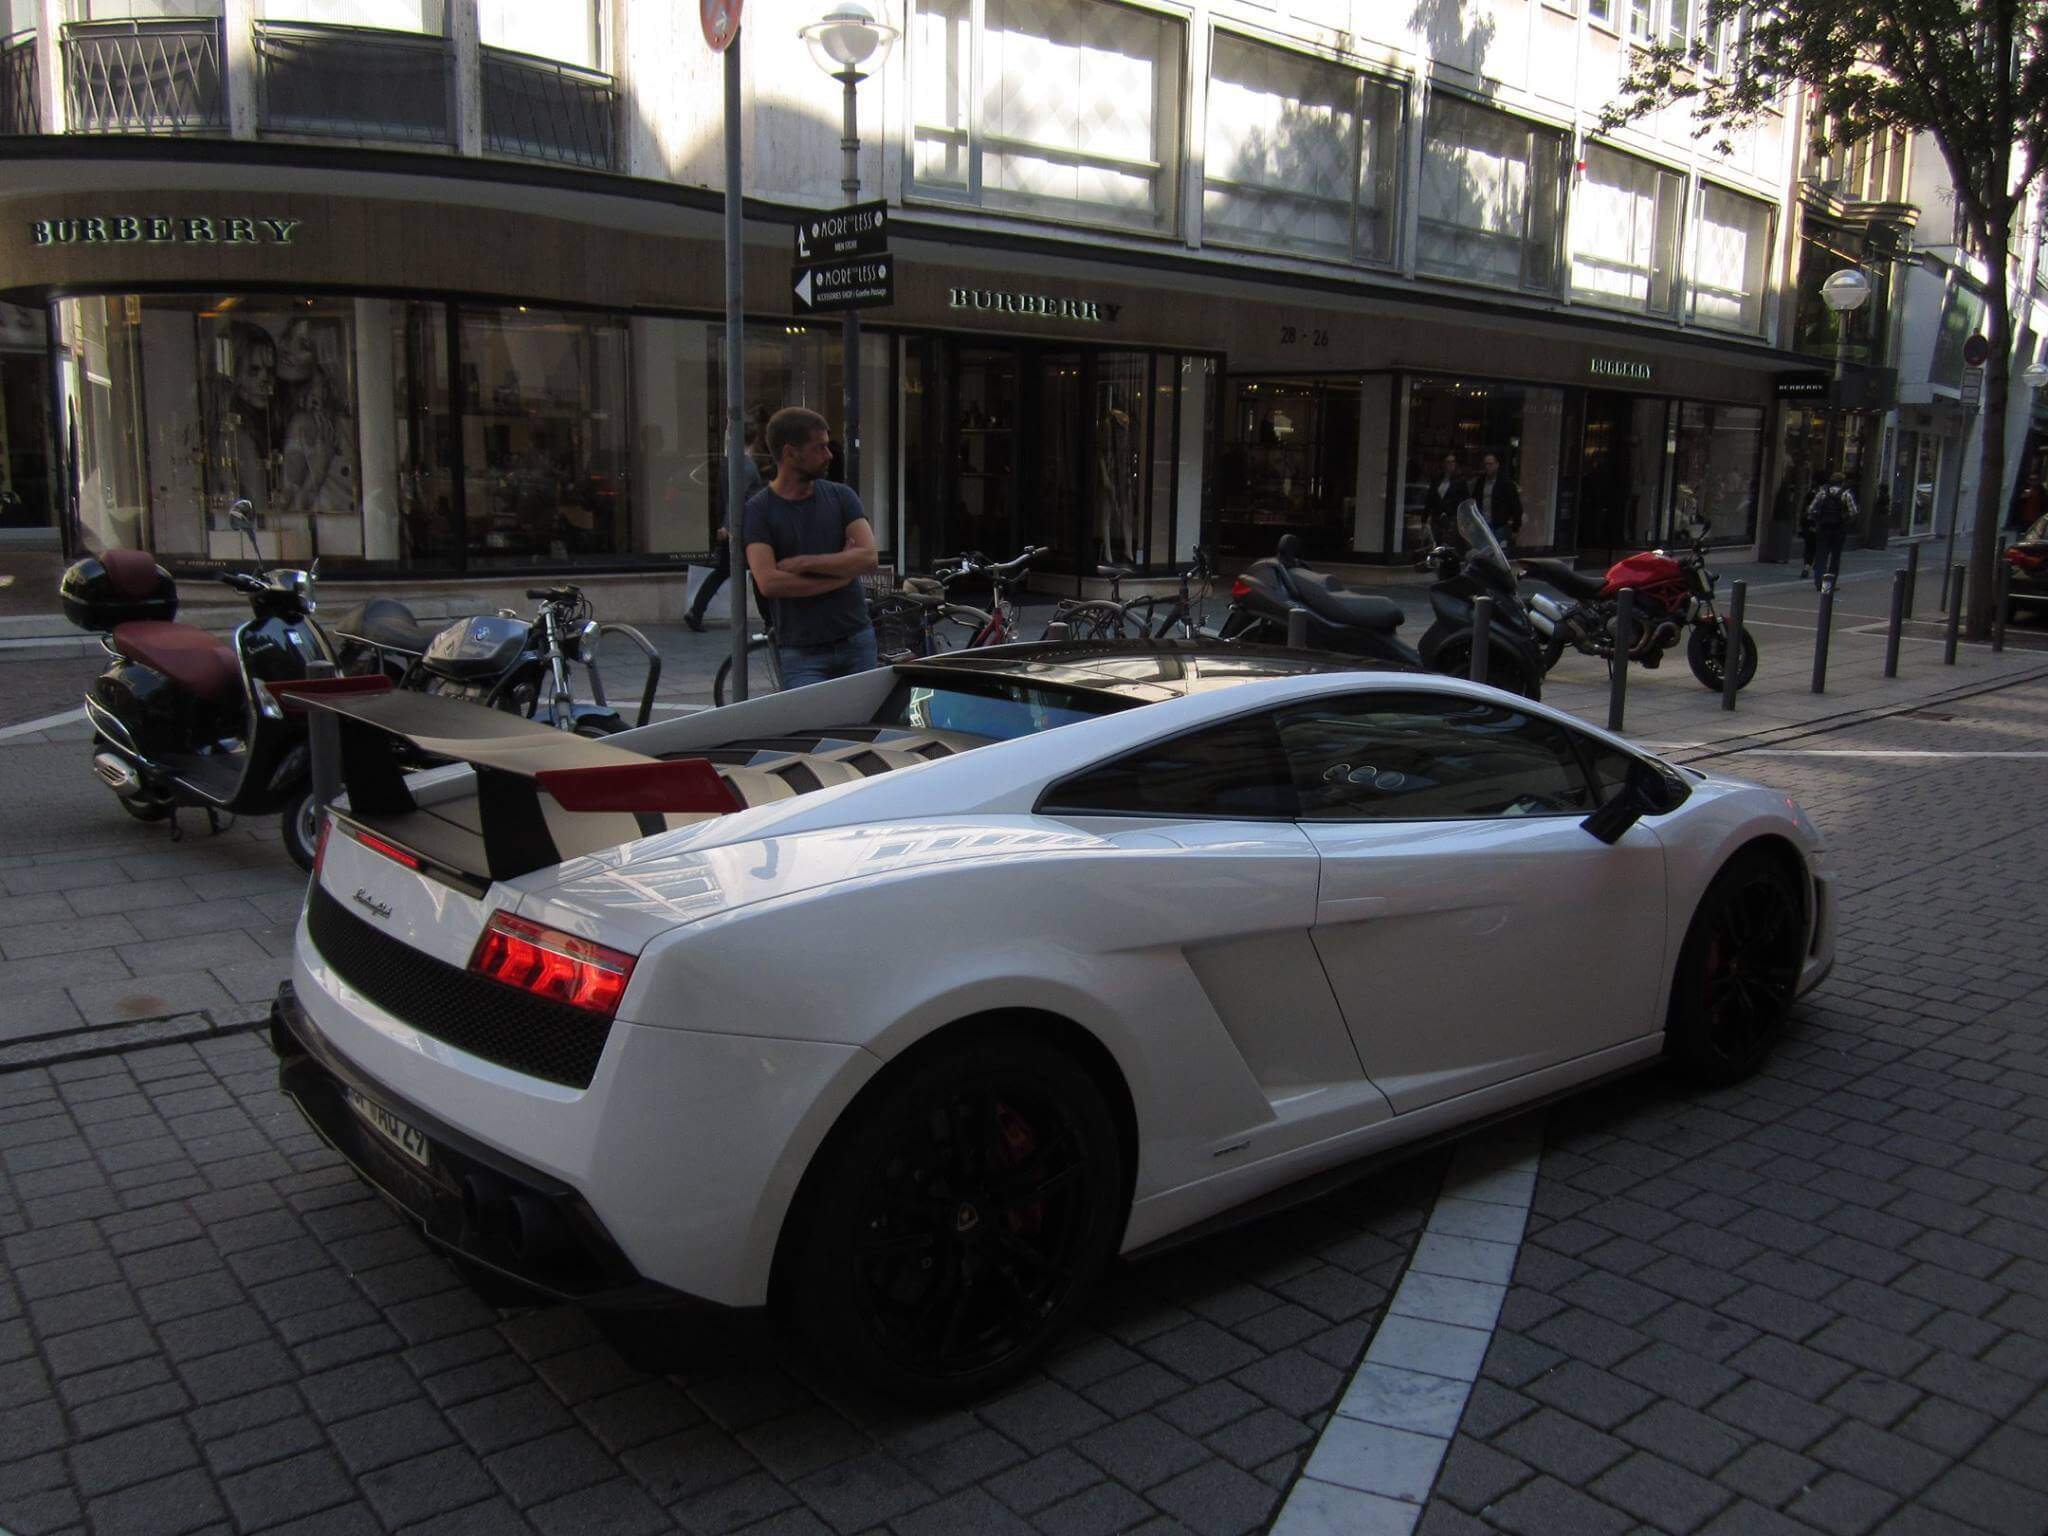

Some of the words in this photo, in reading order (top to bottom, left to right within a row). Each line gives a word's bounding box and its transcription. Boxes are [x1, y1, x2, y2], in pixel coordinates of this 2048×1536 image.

[32, 215, 299, 246] BURBERRY
[821, 216, 847, 238] MORE
[854, 211, 873, 233] LESS
[825, 267, 851, 287] MORE
[858, 263, 876, 283] LESS
[949, 287, 1122, 322] BURBERRY
[1280, 326, 1297, 344] 28
[1312, 329, 1329, 347] 26
[1590, 358, 1652, 379] BURBERRY
